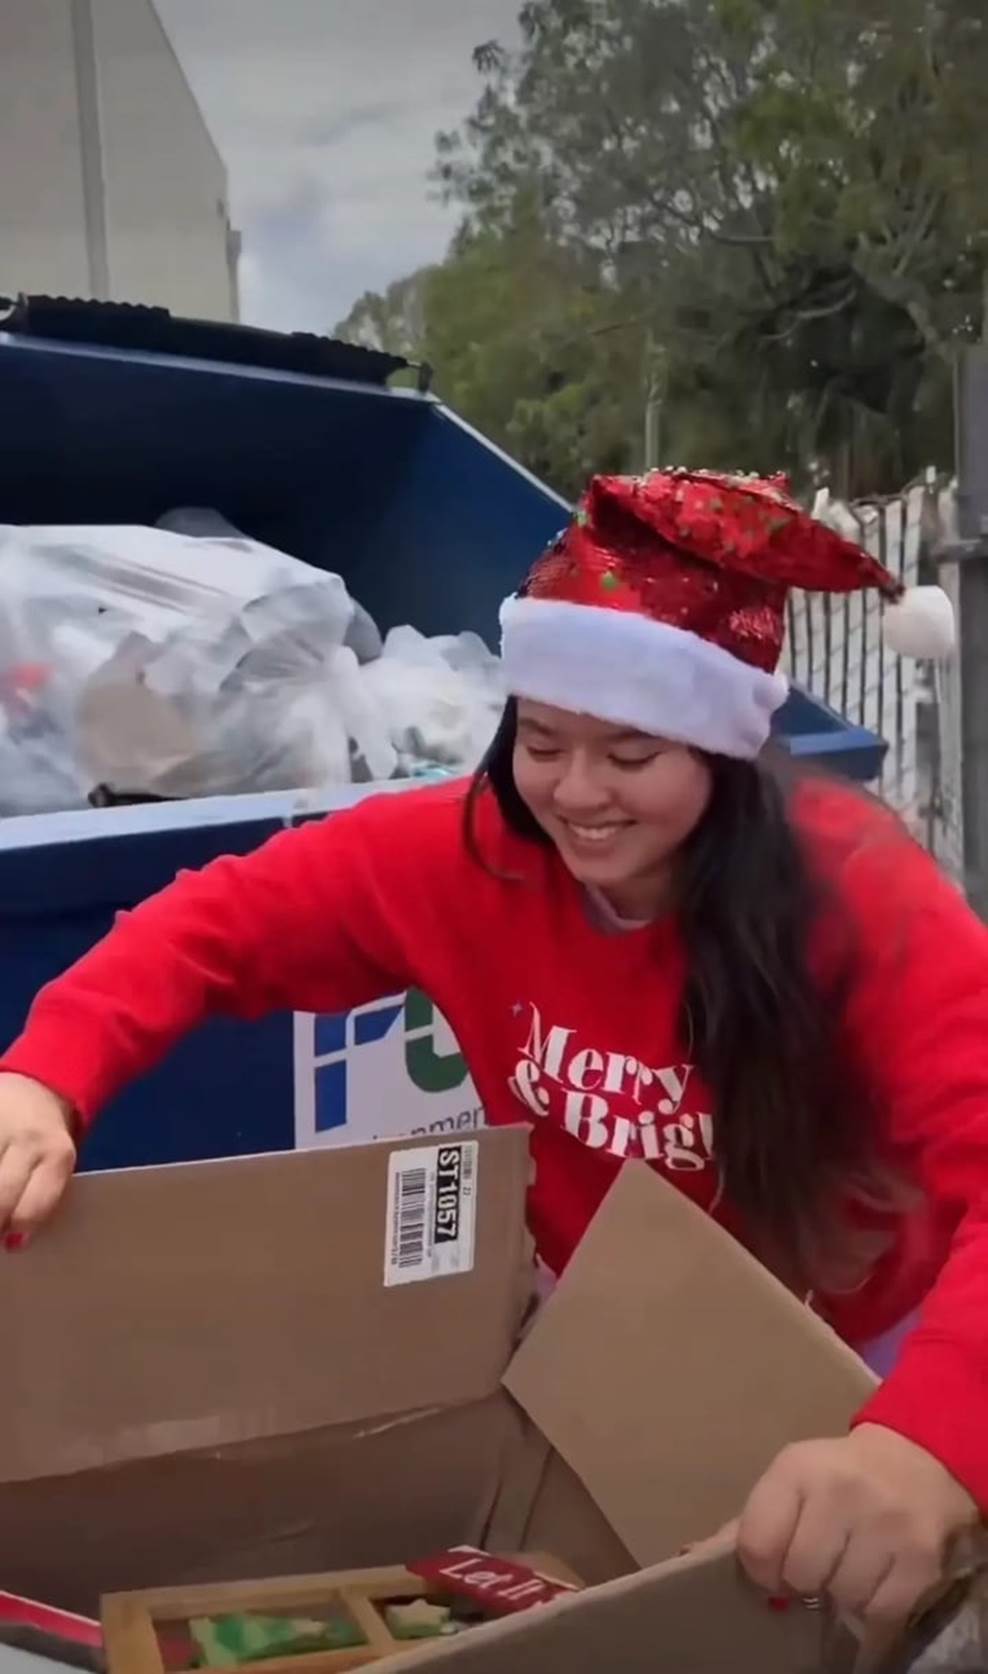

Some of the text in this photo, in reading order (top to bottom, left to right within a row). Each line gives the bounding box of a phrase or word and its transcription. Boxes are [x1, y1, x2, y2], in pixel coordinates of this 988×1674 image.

[507, 1059, 549, 1117] &
[517, 1001, 694, 1115] Merry
[437, 1150, 460, 1237] ST1057
[439, 1558, 514, 1589] Let
